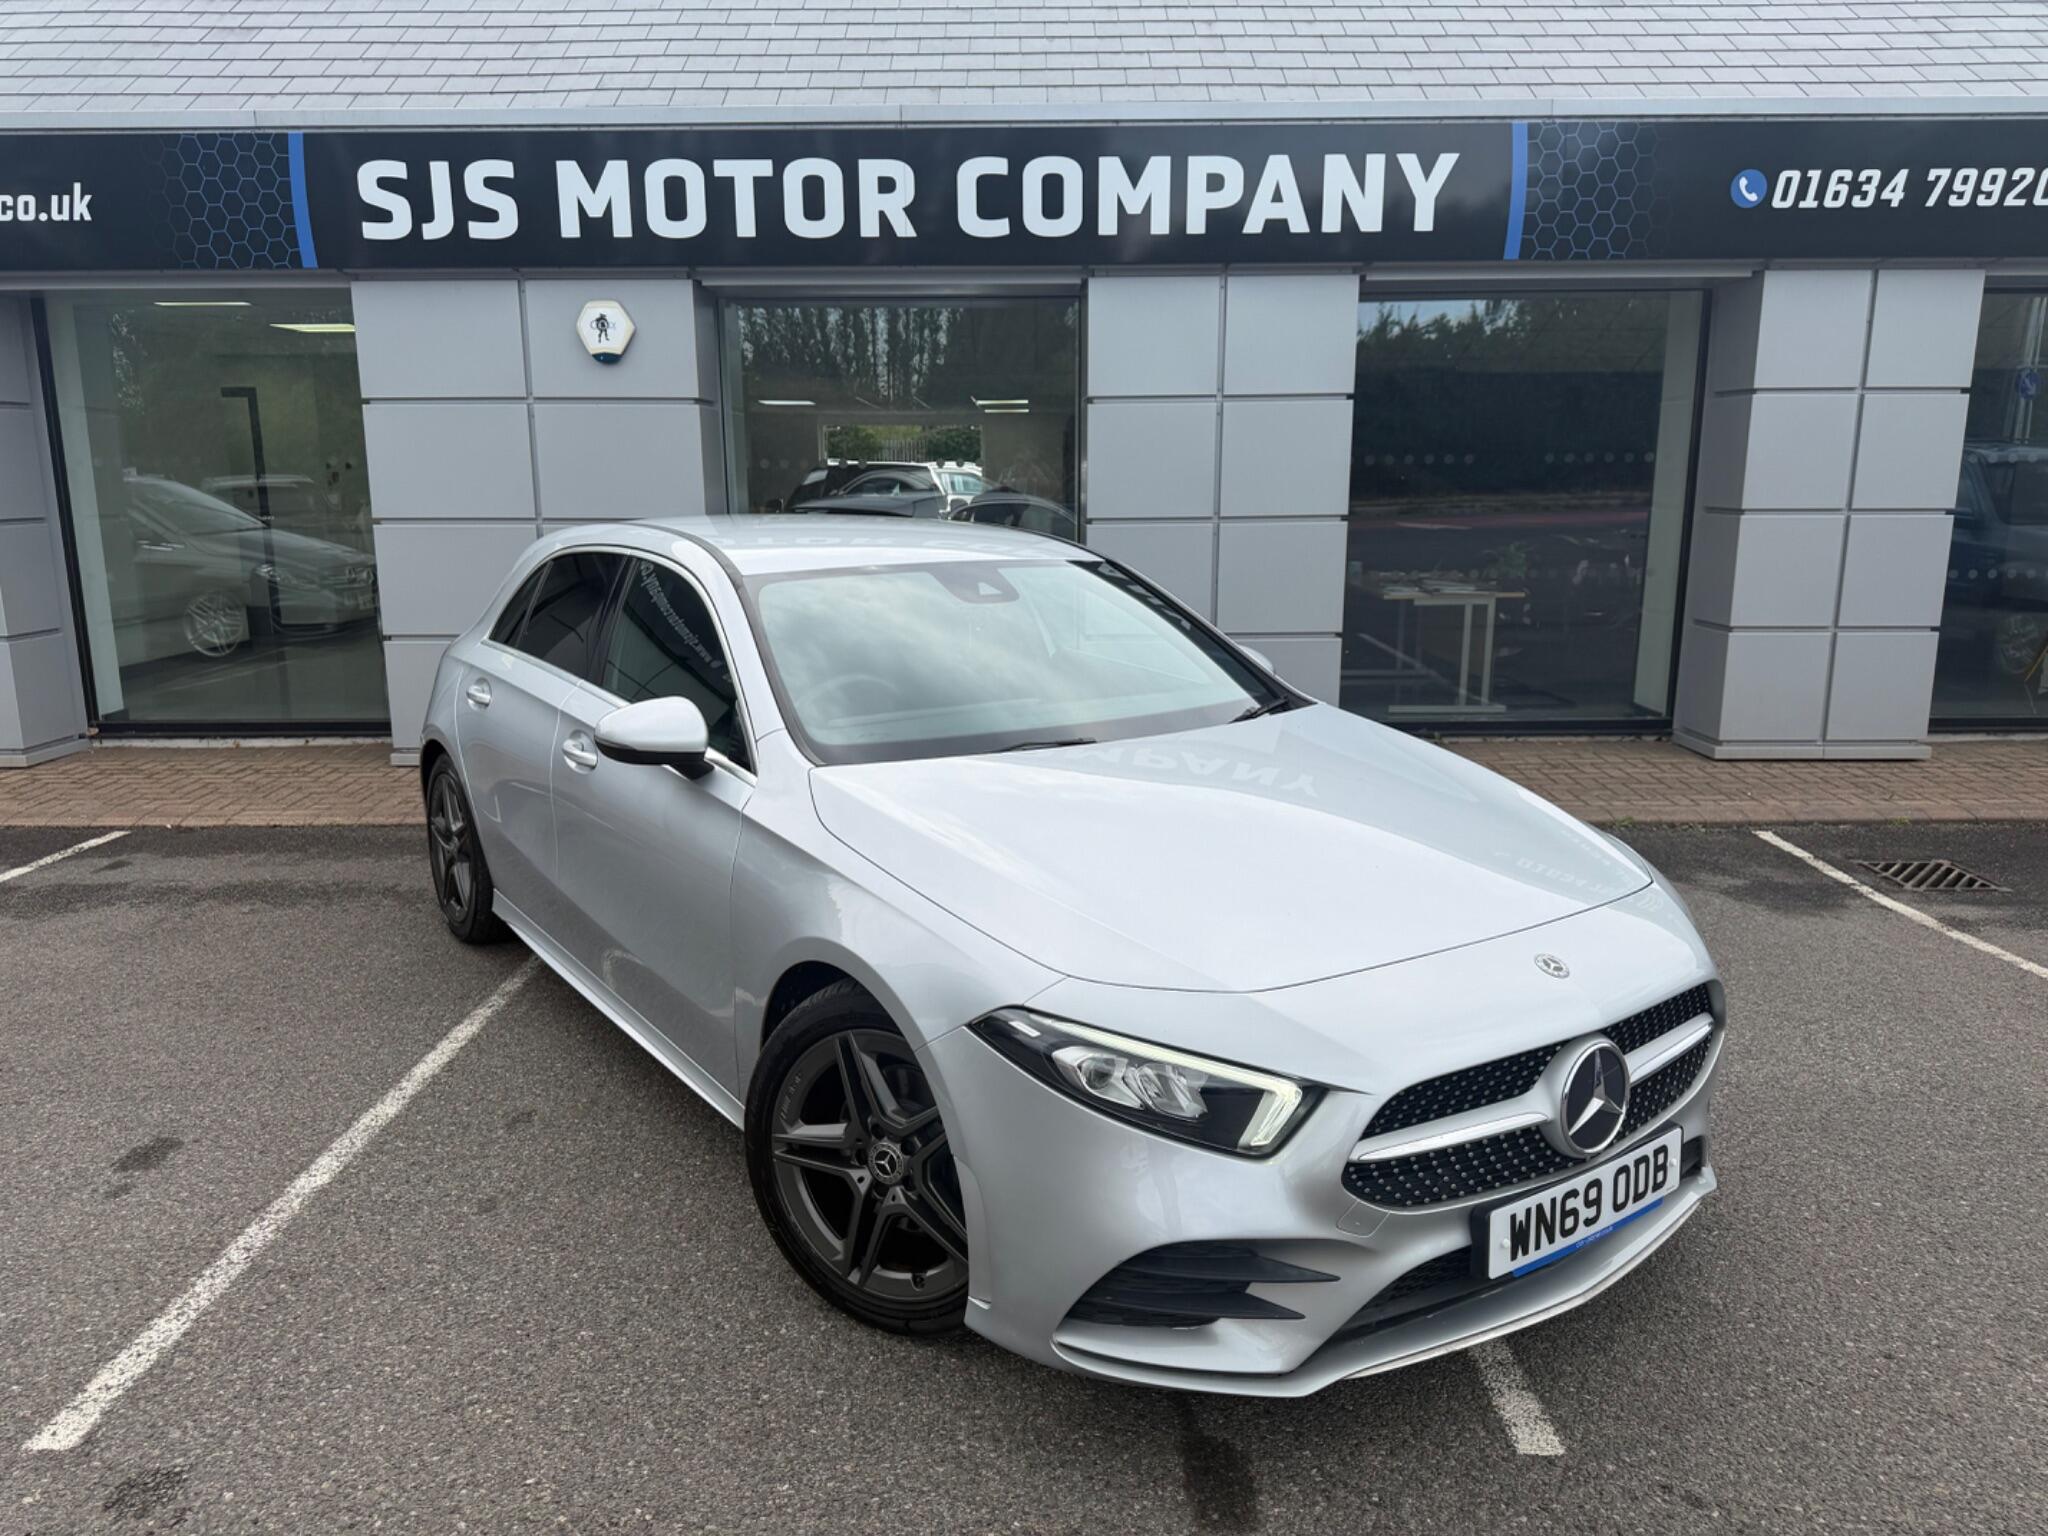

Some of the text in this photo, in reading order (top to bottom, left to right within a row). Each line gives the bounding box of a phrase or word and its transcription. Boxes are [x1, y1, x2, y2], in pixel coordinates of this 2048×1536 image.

[356, 152, 1461, 240] SJS MOTOR COMPANY
[1771, 168, 1909, 209] 01634
[1510, 1144, 1669, 1262] WN69 ODB
